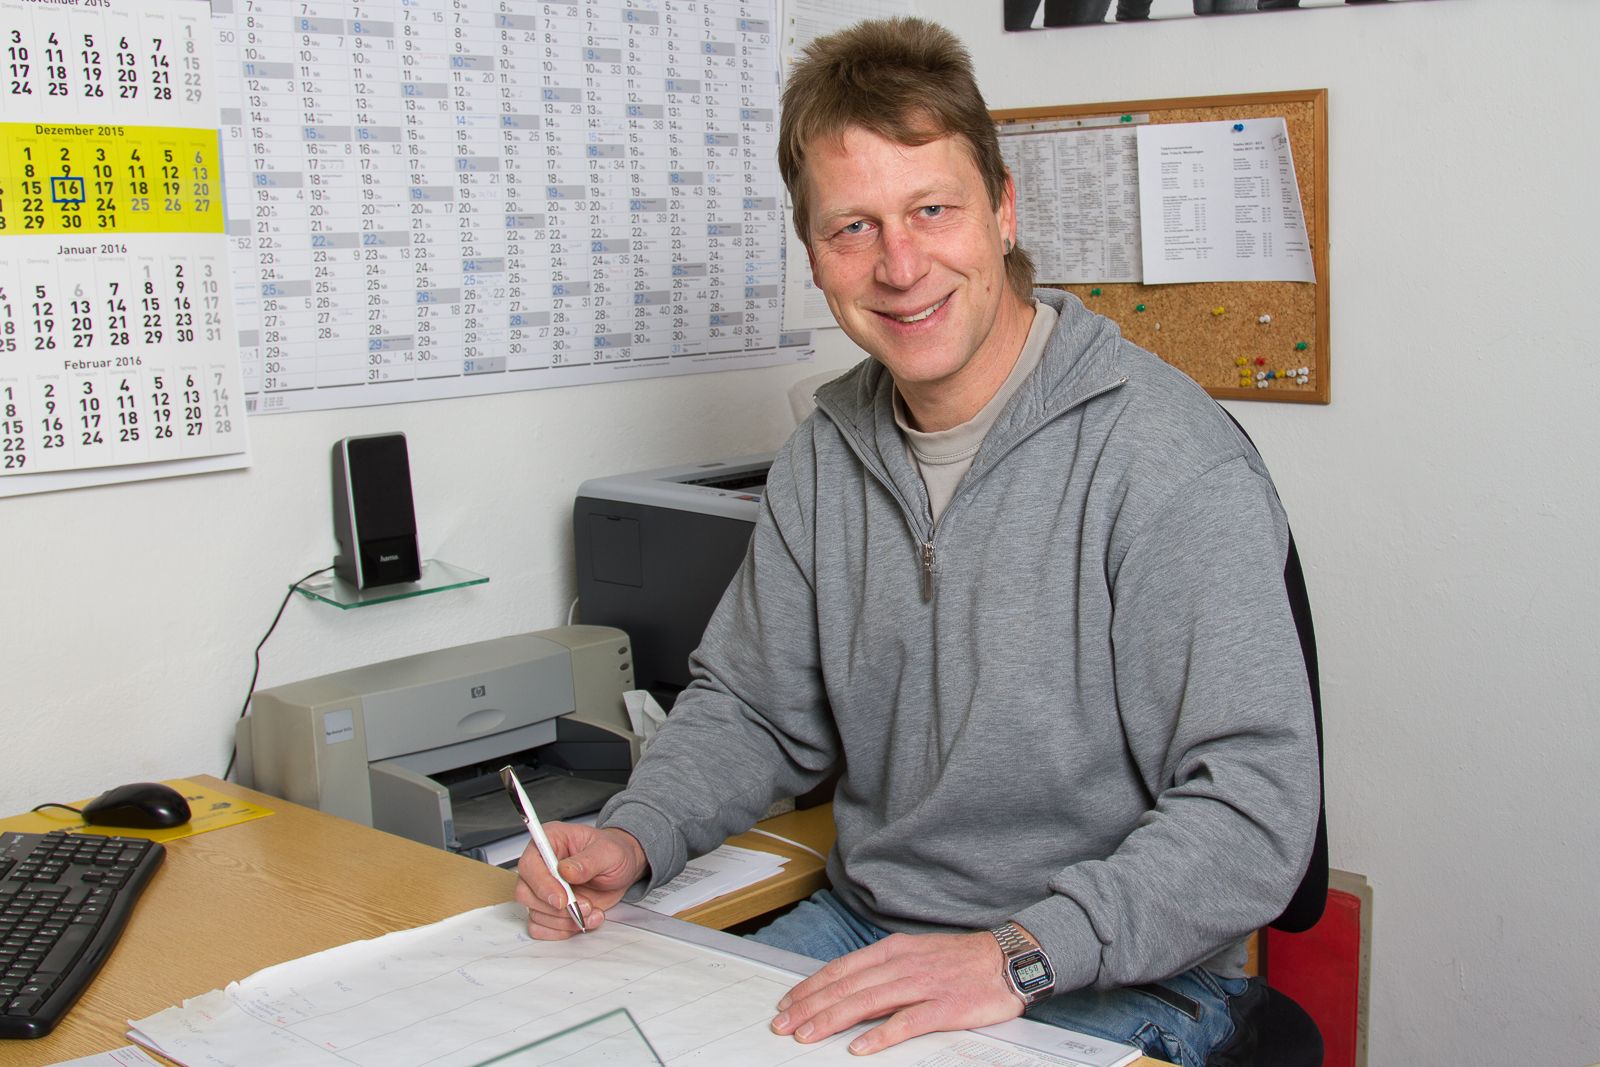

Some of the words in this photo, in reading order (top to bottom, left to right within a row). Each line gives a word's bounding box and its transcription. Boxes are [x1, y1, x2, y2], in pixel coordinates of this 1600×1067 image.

[185, 25, 192, 38] 1
[12, 30, 21, 43] 3
[48, 33, 58, 45] 4
[84, 34, 93, 47] 5
[120, 37, 128, 49] 6
[153, 39, 162, 51] 7
[186, 41, 194, 54] 8
[8, 47, 28, 60] 10
[46, 49, 63, 62] 11
[82, 51, 100, 64] 12
[117, 53, 135, 66] 13
[151, 55, 169, 67] 14
[184, 57, 200, 70] 15
[10, 64, 29, 77] 17
[47, 66, 66, 79] 18
[83, 68, 101, 80] 19
[118, 69, 136, 82] 20
[152, 71, 168, 84] 21
[184, 73, 201, 86] 22
[12, 81, 32, 94] 24
[48, 82, 68, 96] 25
[85, 84, 103, 97] 26
[120, 86, 138, 98] 27
[154, 87, 171, 100] 28
[186, 89, 202, 102] 29
[36, 125, 94, 135] Dezember
[98, 126, 124, 136] 2015
[24, 147, 31, 160] 1
[60, 148, 70, 161] 2
[96, 148, 105, 161] 3
[131, 149, 140, 162] 4
[164, 150, 172, 162] 5
[195, 152, 202, 164] 6
[25, 164, 34, 177] 8
[62, 165, 70, 177] 9
[94, 165, 112, 178] 10
[128, 166, 144, 178] 11
[162, 166, 179, 178] 12
[193, 167, 208, 180] 13
[22, 182, 41, 194] 15
[59, 181, 78, 194] 16
[95, 182, 113, 194] 17
[130, 182, 148, 194] 18
[164, 182, 180, 195] 19
[194, 183, 209, 196] 20
[23, 198, 43, 212] 22
[96, 198, 116, 211] 24
[131, 198, 149, 211] 25
[164, 198, 181, 211] 26
[195, 199, 210, 212] 27
[24, 216, 44, 229] 29
[62, 215, 81, 228] 30
[98, 215, 115, 228] 31
[58, 246, 97, 254] Januar
[101, 244, 127, 253] 2016
[144, 265, 150, 278] 1
[176, 265, 183, 277] 2
[205, 264, 212, 277] 3
[36, 286, 46, 298] 5
[74, 284, 83, 297] 6
[110, 283, 118, 295] 7
[145, 282, 153, 294] 8
[177, 281, 184, 293] 9
[202, 280, 218, 293] 10
[33, 302, 53, 316] 12
[71, 301, 90, 314] 13
[108, 299, 126, 312] 14
[142, 298, 159, 311] 15
[174, 297, 190, 310] 16
[204, 296, 218, 309] 17
[34, 319, 54, 333] 19
[72, 318, 92, 331] 20
[109, 316, 126, 329] 21
[144, 314, 161, 327] 22
[176, 313, 192, 326] 23
[205, 312, 221, 325] 24
[35, 336, 56, 350] 26
[74, 334, 93, 348] 27
[110, 332, 129, 345] 28
[145, 330, 162, 343] 29
[177, 329, 193, 342] 30
[206, 328, 220, 341] 31
[64, 360, 112, 370] Februar
[116, 356, 142, 366] 2016
[5, 387, 12, 400] 1
[45, 384, 54, 397] 2
[83, 382, 92, 394] 3
[120, 379, 129, 391] 4
[154, 377, 163, 389] 5
[186, 375, 194, 387] 6
[214, 373, 222, 385] 7
[6, 404, 16, 417] 8
[46, 401, 55, 414] 9
[80, 398, 99, 411] 10
[117, 395, 134, 408] 11
[152, 393, 169, 406] 12
[184, 390, 200, 403] 13
[213, 388, 228, 401] 14
[2, 420, 23, 434] 15
[42, 418, 62, 431] 16
[82, 414, 100, 428] 17
[119, 412, 138, 425] 18
[154, 409, 170, 422] 19
[185, 407, 201, 420] 20
[214, 404, 228, 417] 21
[3, 438, 24, 452] 22
[43, 434, 64, 448] 23
[82, 431, 103, 445] 24
[120, 428, 139, 442] 25
[155, 425, 172, 438] 26
[187, 422, 202, 436] 27
[216, 420, 231, 433] 28
[5, 454, 26, 468] 29
